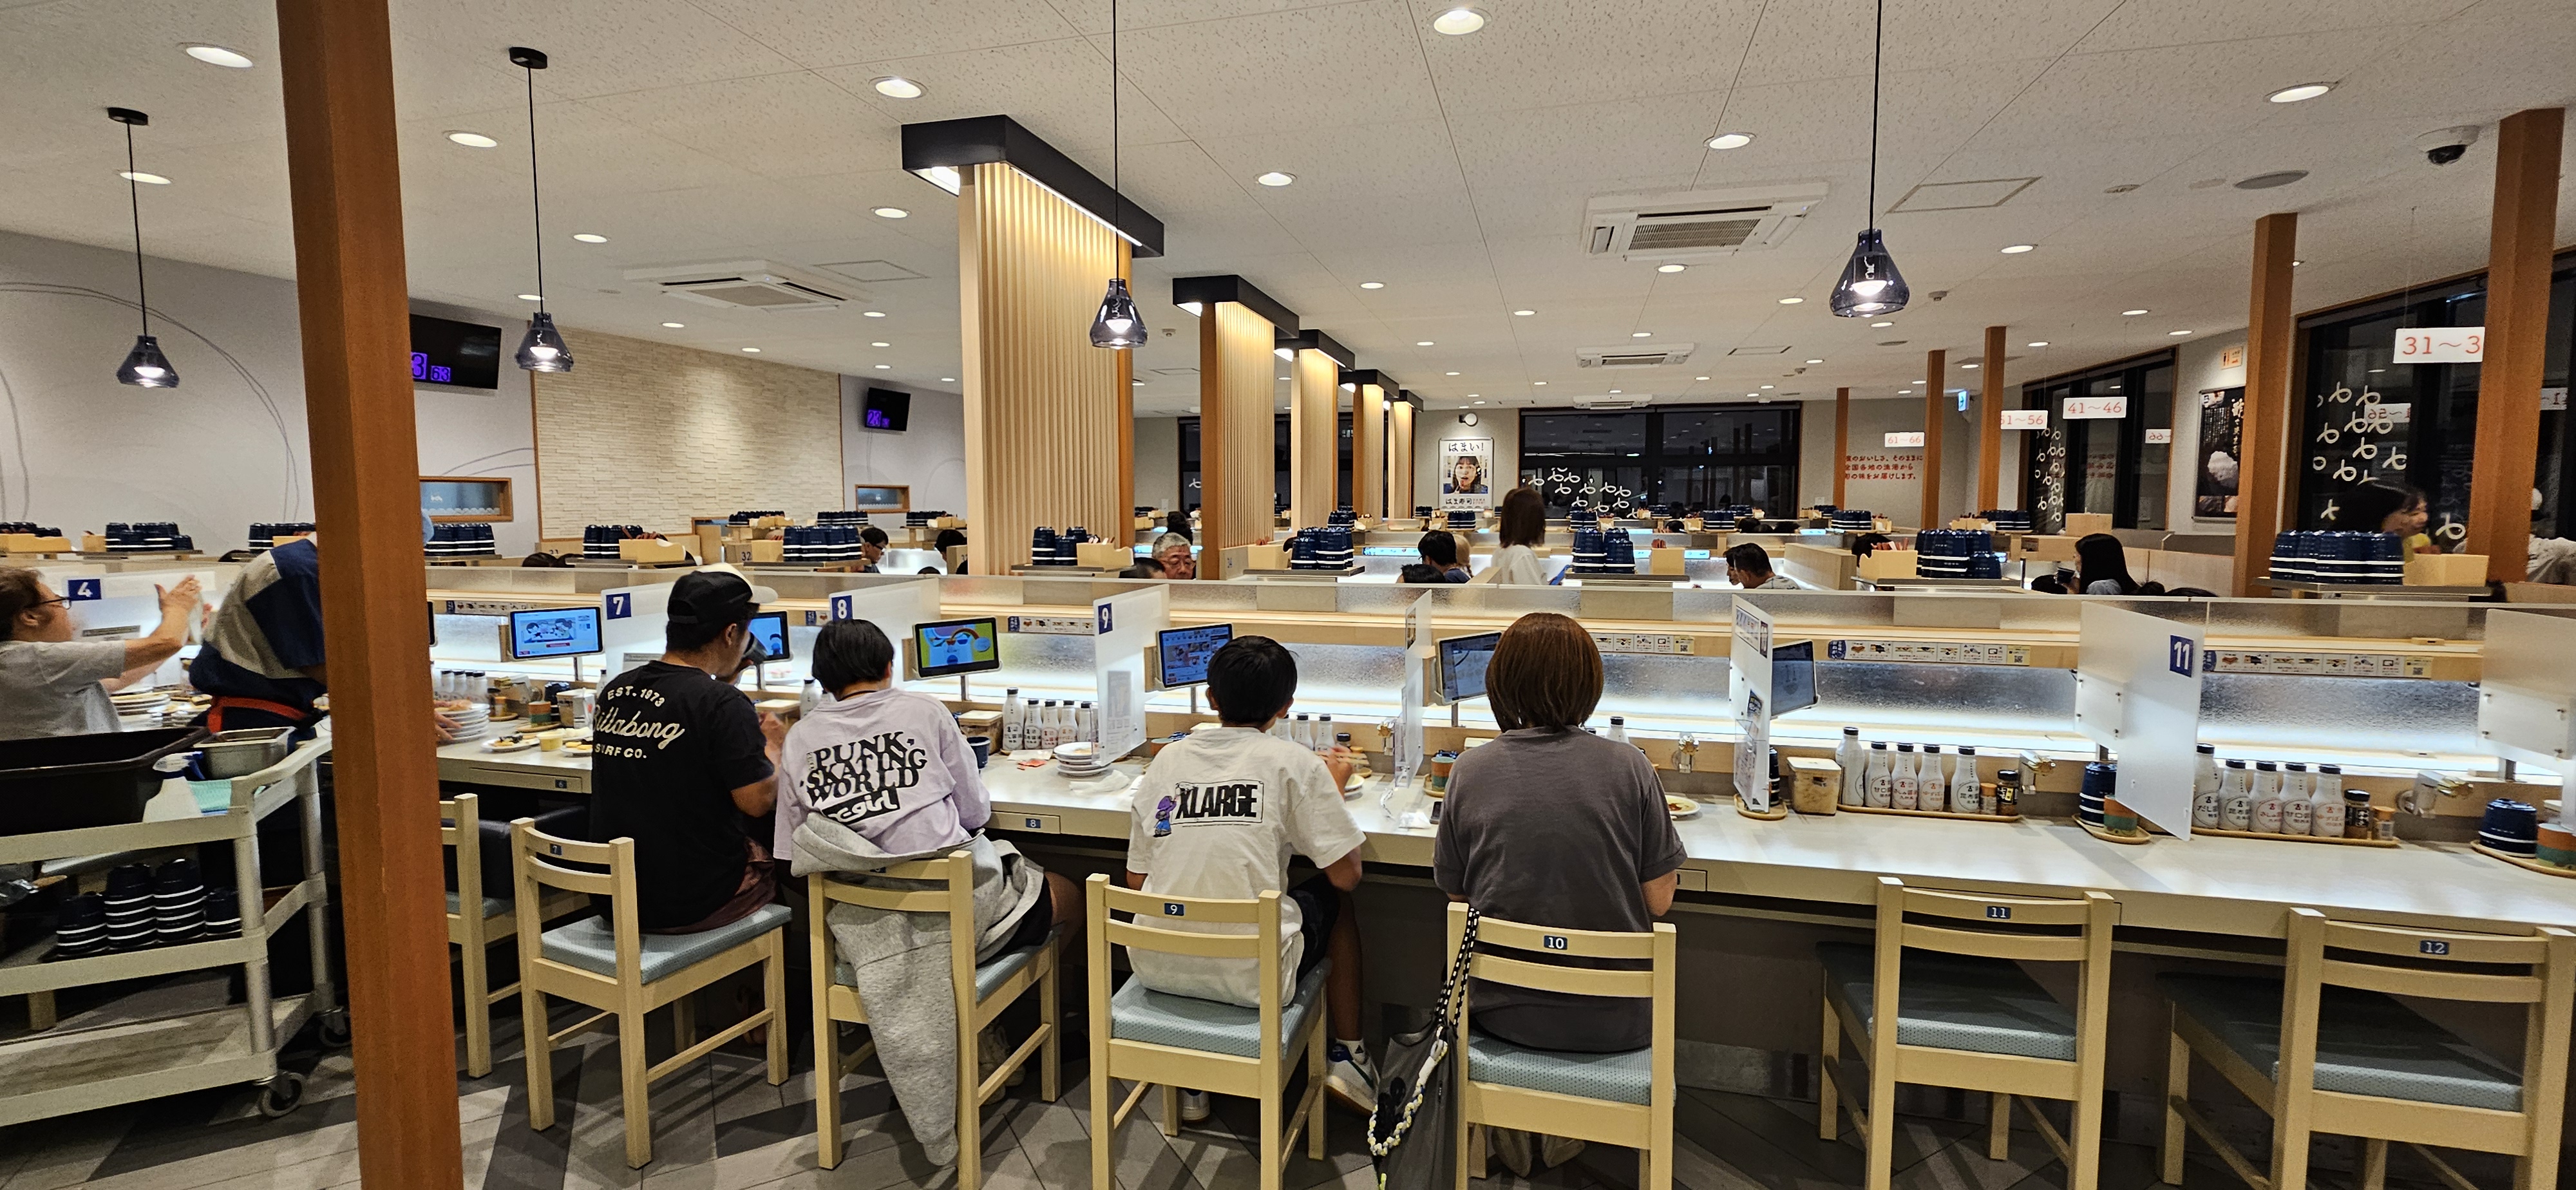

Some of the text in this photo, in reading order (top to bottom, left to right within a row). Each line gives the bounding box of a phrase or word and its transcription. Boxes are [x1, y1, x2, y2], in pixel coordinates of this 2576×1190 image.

[431, 366, 450, 381] 63
[741, 551, 752, 562] 32
[77, 581, 93, 598] 4
[612, 596, 625, 616] 7
[837, 599, 848, 619] 8
[1102, 607, 1109, 629] 9
[2174, 641, 2191, 670] 11
[607, 685, 665, 707] EST. 1973
[623, 748, 647, 759] CO.
[806, 748, 928, 788] SKATING
[806, 767, 920, 807] WORLD
[1030, 819, 1037, 827] 8
[1170, 904, 1178, 914] 9
[1991, 907, 2007, 918] 11
[1548, 937, 1565, 949] 10
[2425, 941, 2446, 954] 12
